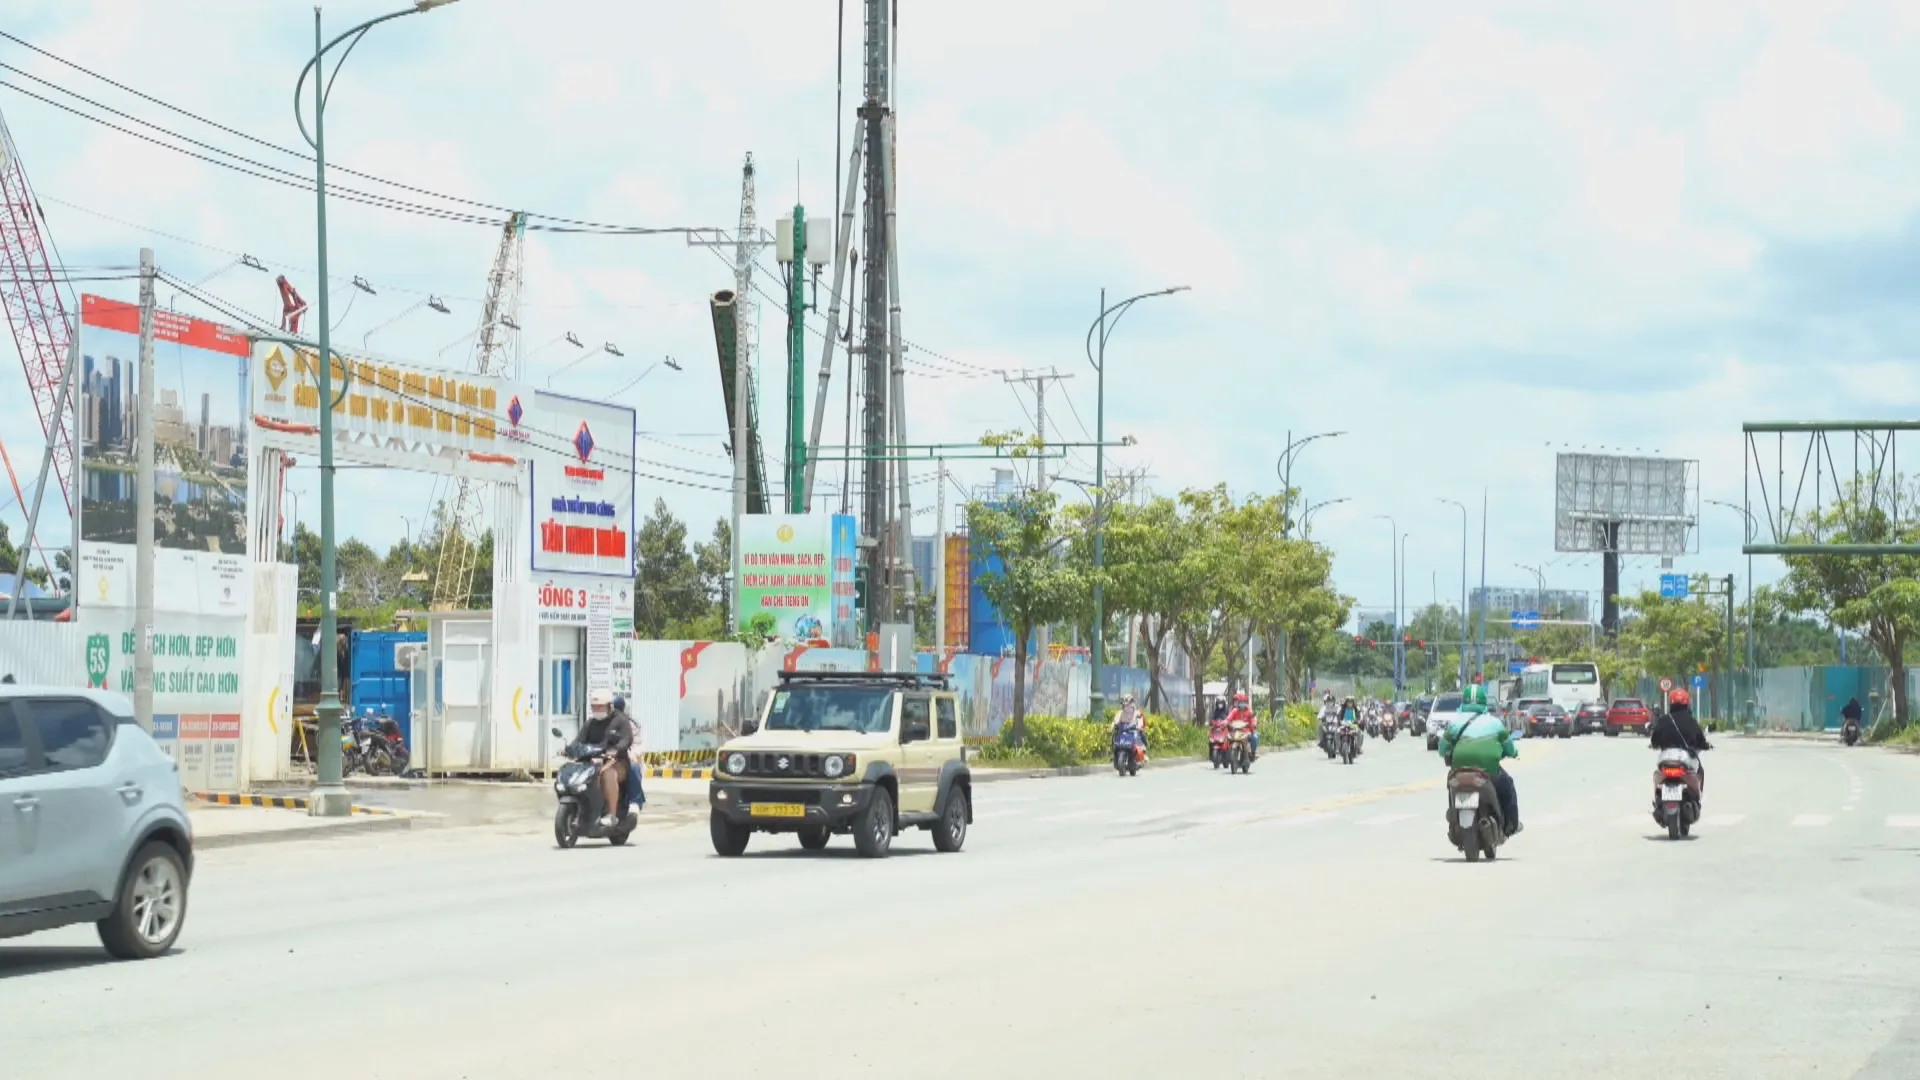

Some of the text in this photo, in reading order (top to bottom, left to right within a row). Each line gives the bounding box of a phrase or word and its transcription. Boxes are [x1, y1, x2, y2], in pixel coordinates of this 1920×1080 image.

[578, 589, 587, 609] 3
[90, 647, 106, 673] 5S
[195, 635, 214, 662] ĐẸP
[216, 635, 236, 658] HƠN
[168, 665, 195, 693] SUẤT
[196, 671, 216, 694] CAO
[218, 672, 238, 694] HƠN
